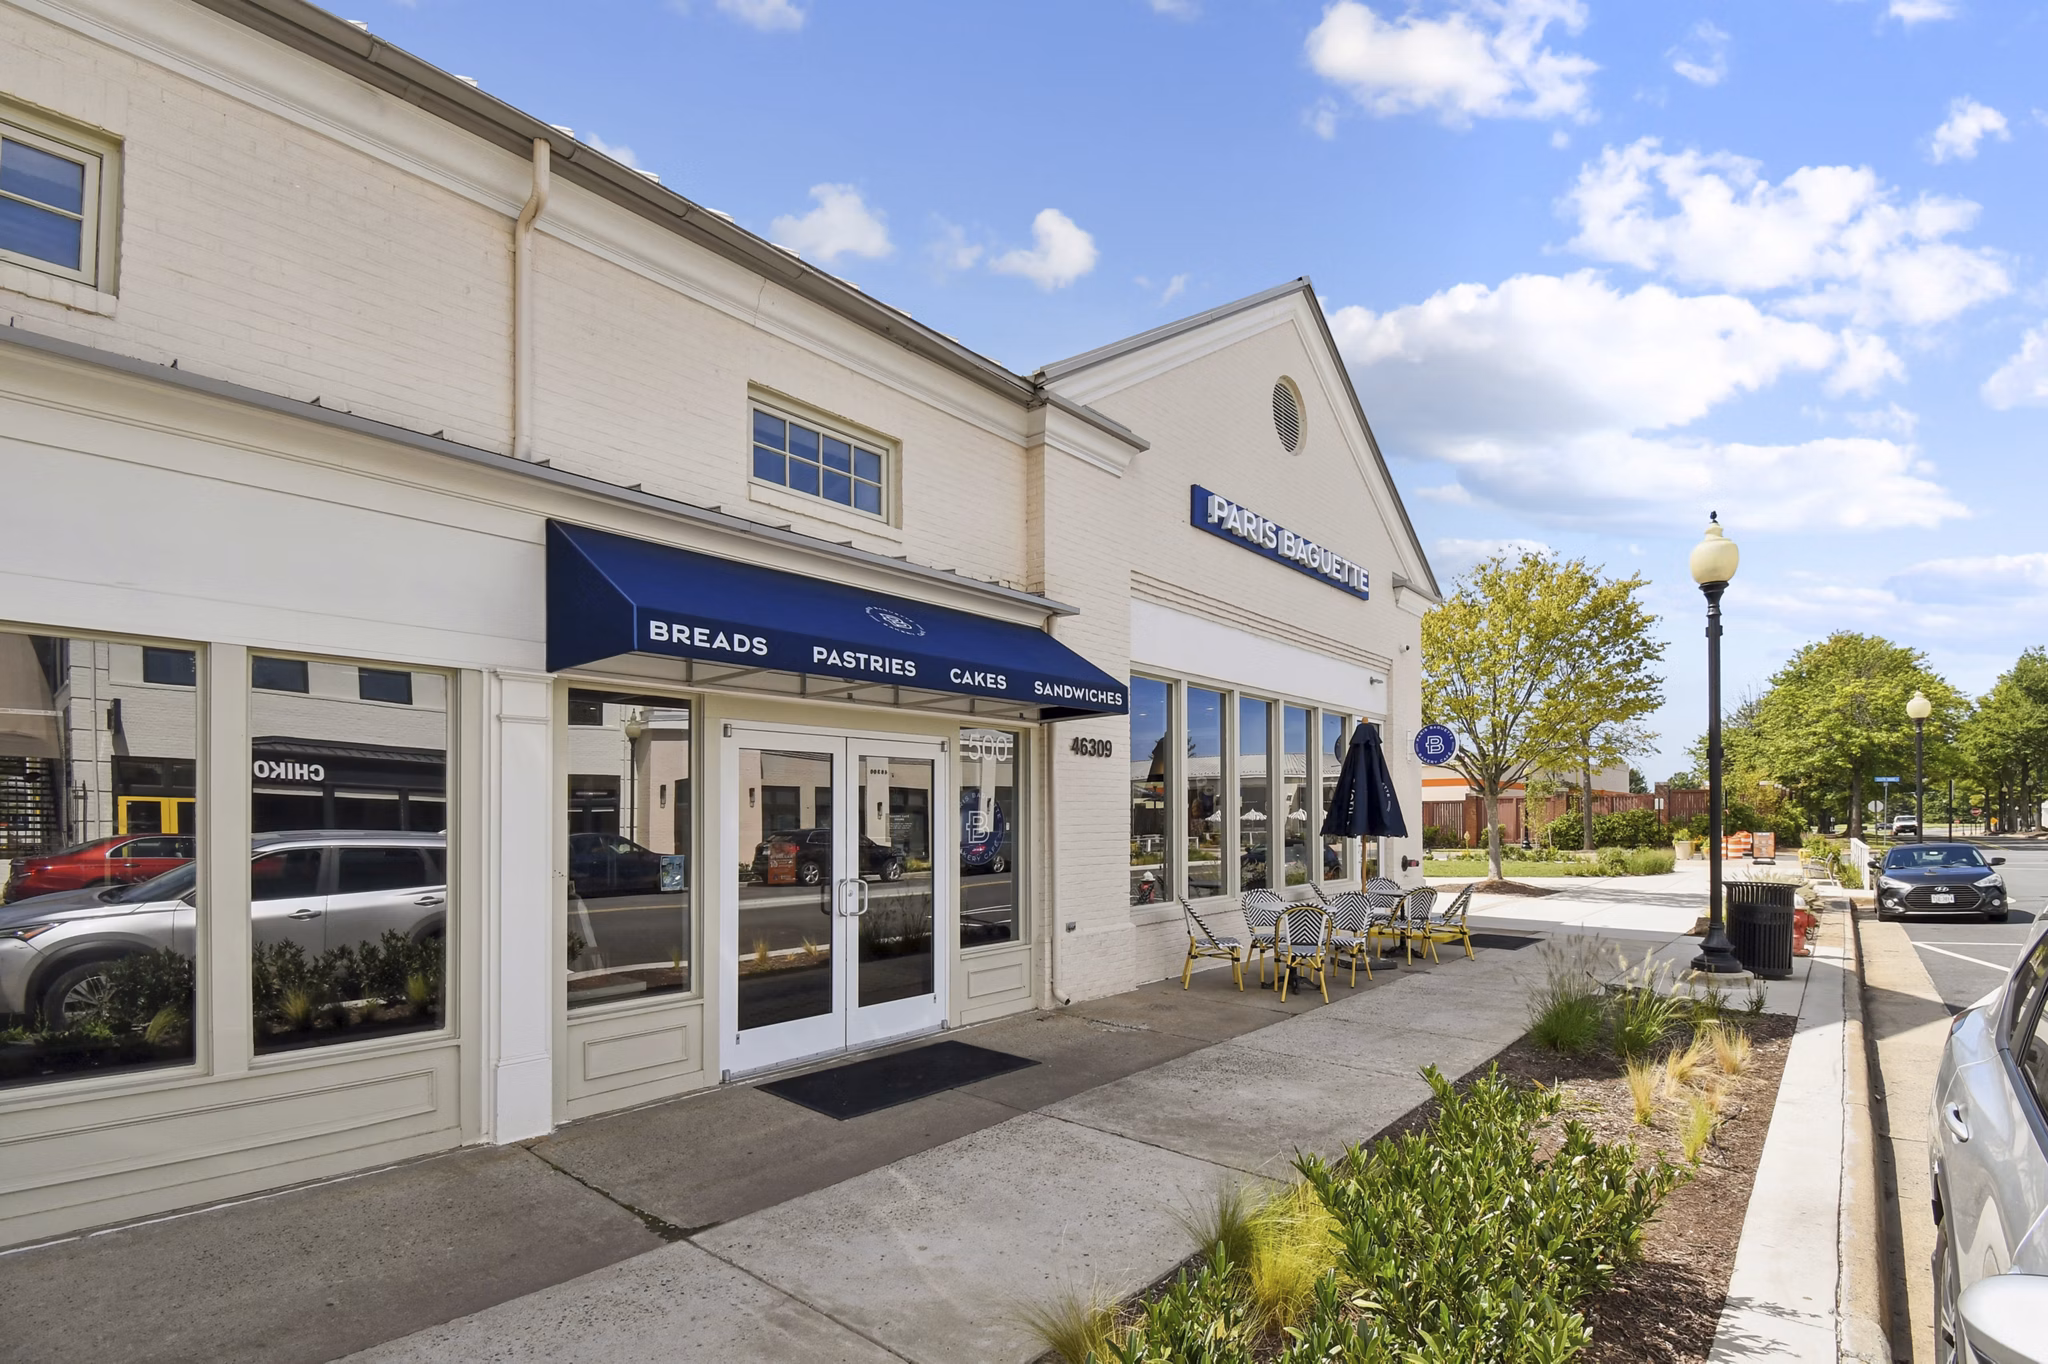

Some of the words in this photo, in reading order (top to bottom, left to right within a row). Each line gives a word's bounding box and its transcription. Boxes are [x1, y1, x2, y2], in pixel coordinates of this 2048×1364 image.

[1207, 494, 1277, 549] PARIS
[1278, 529, 1369, 592] BAGUETTE
[649, 620, 768, 656] BREADS
[813, 646, 917, 677] PASTRIES
[950, 668, 1007, 690] CAKES
[1034, 681, 1123, 706] SANDWICHES
[968, 733, 1008, 761] 500
[1070, 736, 1112, 758] 46309
[1425, 735, 1445, 754] B
[966, 811, 990, 843] B
